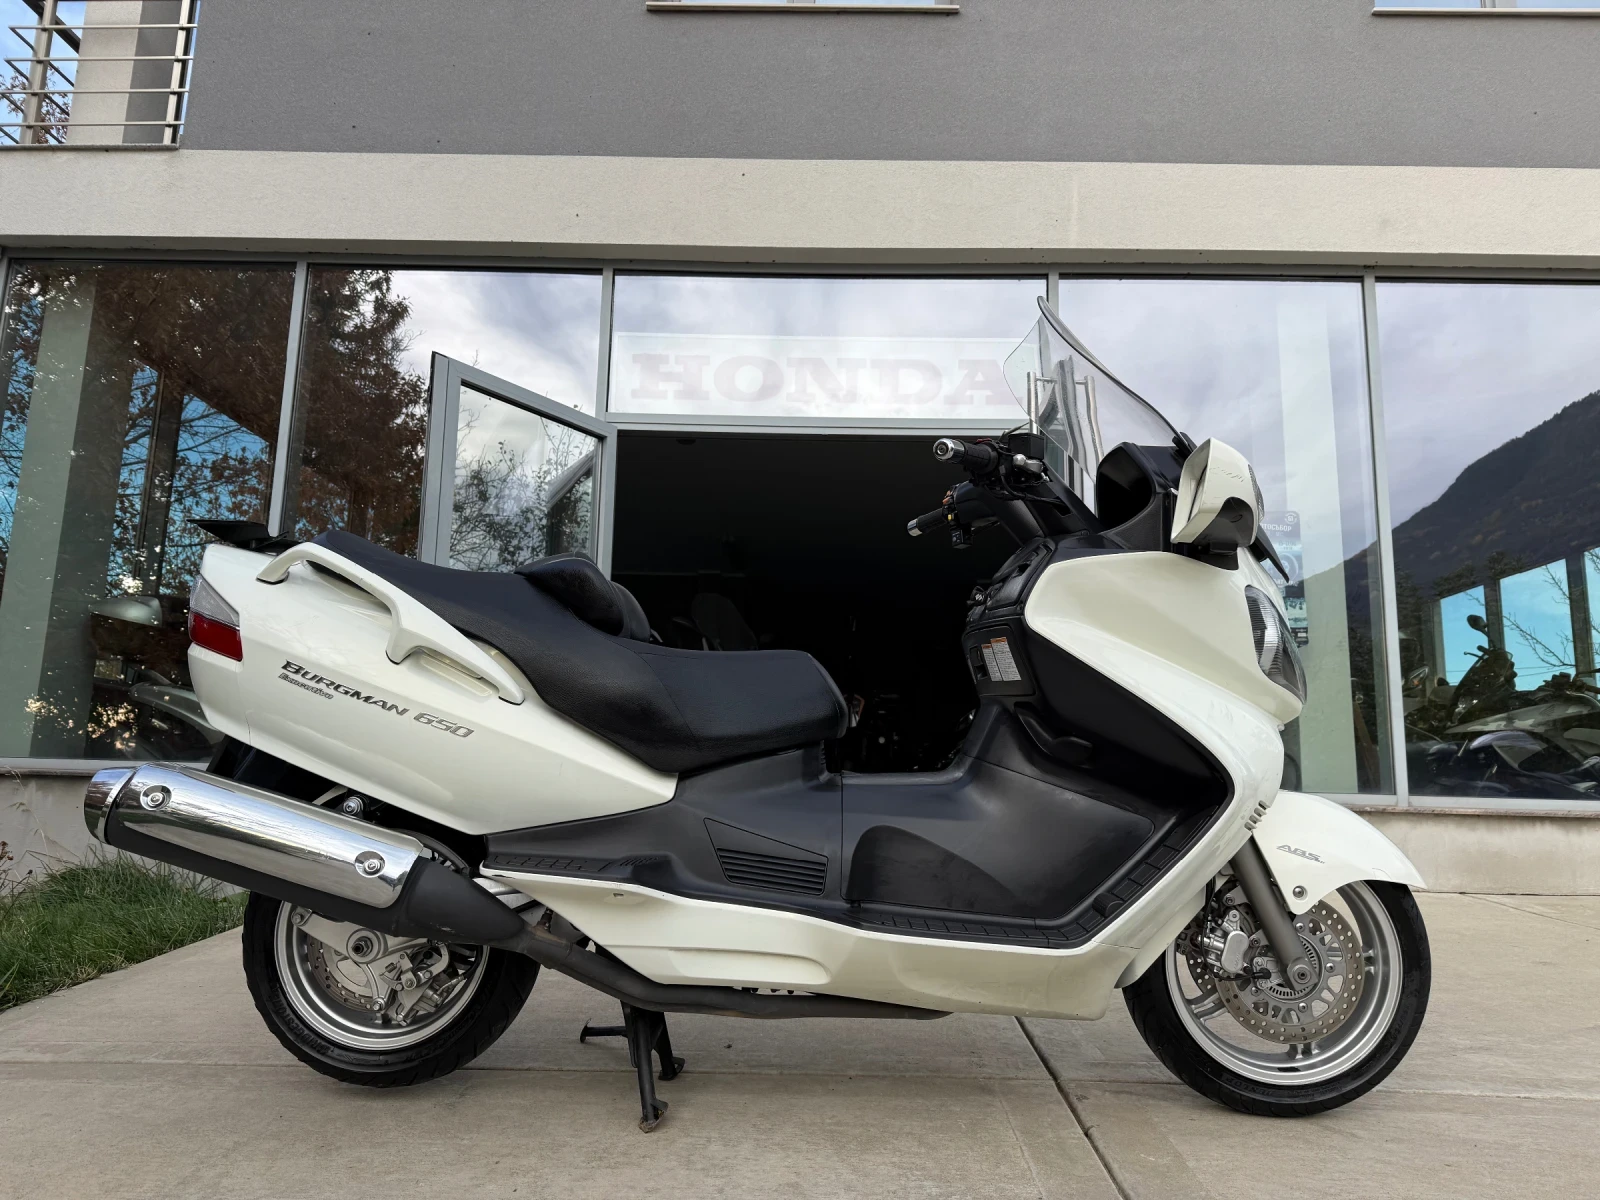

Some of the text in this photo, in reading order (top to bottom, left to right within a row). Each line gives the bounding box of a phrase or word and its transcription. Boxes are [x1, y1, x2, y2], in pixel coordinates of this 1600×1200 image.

[631, 353, 1023, 406] HONDA
[281, 659, 475, 738] BURGMAN 650
[1276, 844, 1321, 860] ABS
